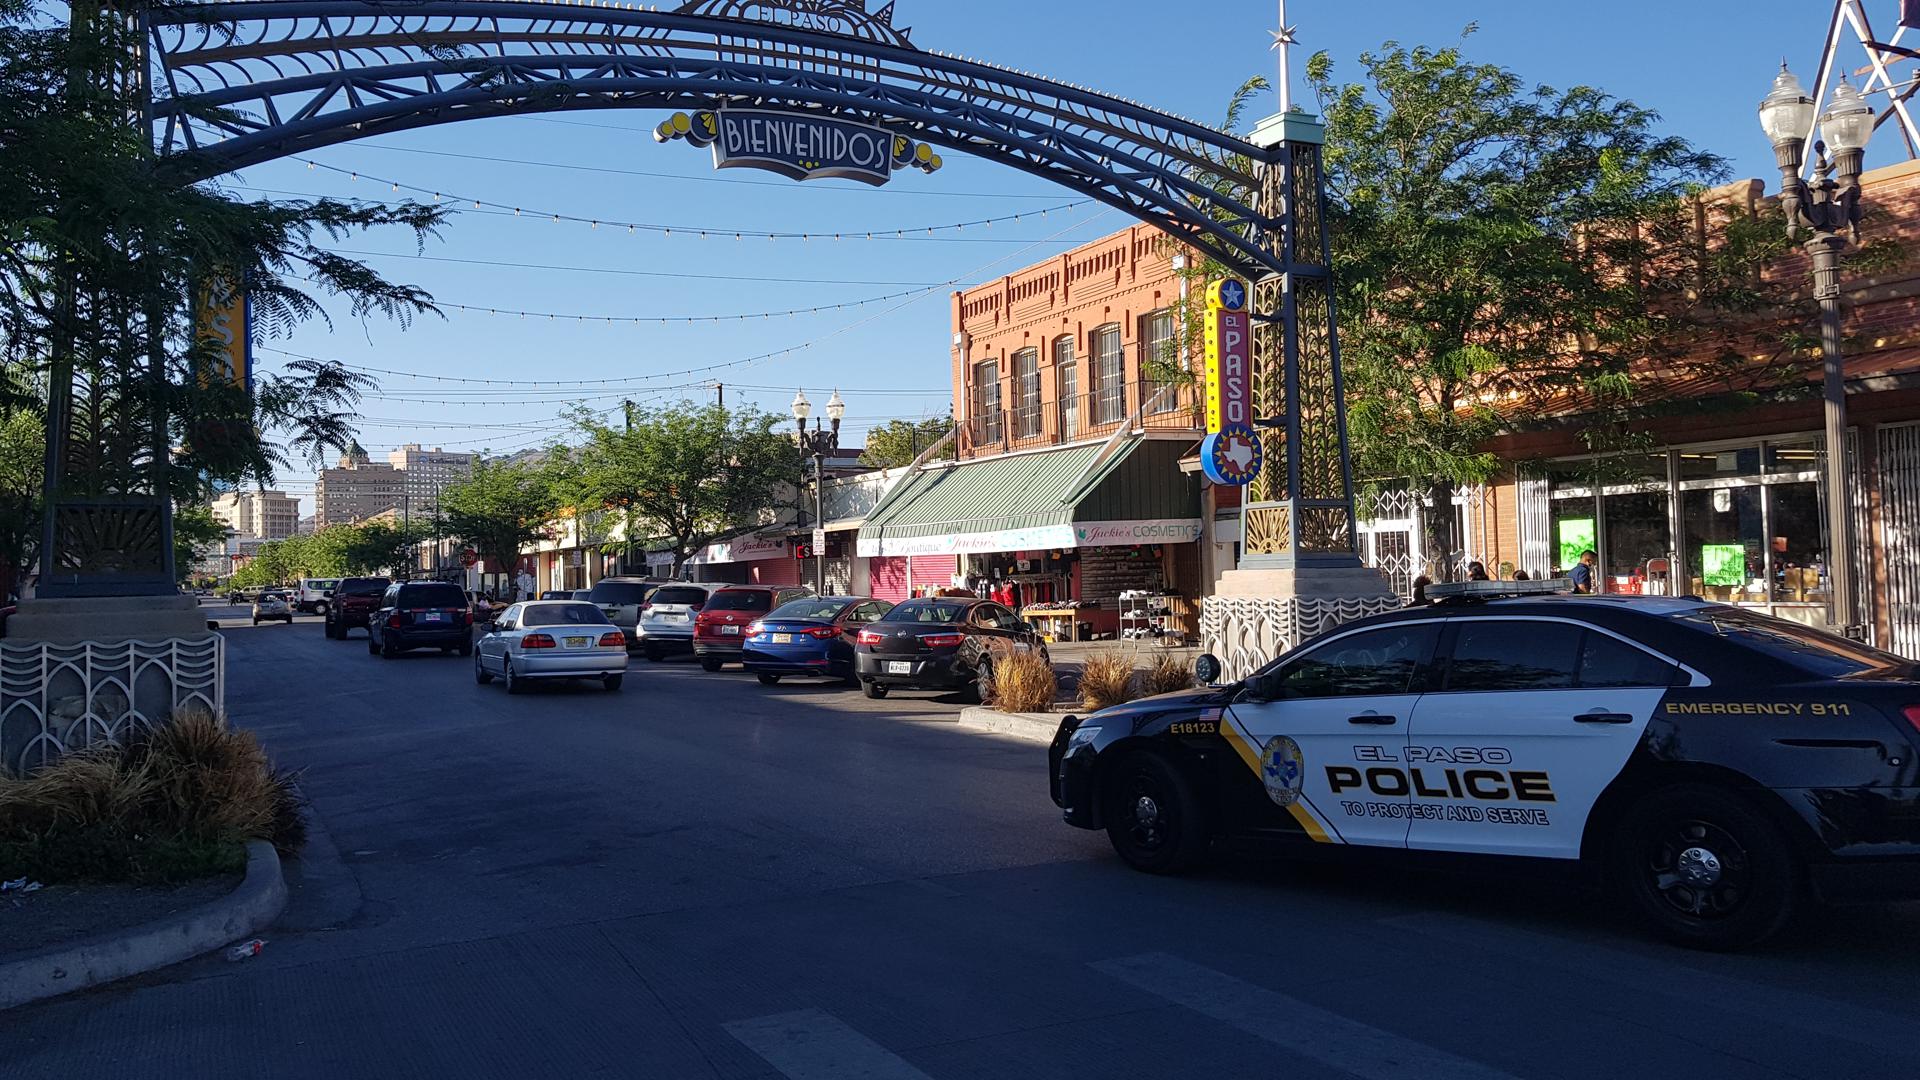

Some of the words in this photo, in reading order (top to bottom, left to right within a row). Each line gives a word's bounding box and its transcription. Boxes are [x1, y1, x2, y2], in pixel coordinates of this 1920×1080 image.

[758, 6, 790, 25] EL
[791, 11, 841, 33] PASO
[725, 118, 885, 169] BIENVENIDOS
[1225, 315, 1240, 328] EL
[1225, 330, 1243, 423] PASO
[1086, 525, 1131, 543] Jackie's
[1132, 524, 1199, 538] COSMETICS
[739, 540, 773, 553] Jackie's
[1665, 702, 1804, 715] EMERGENCY
[1811, 703, 1850, 716] 911
[1170, 722, 1215, 734] E18123
[1353, 745, 1398, 762] EL
[1403, 746, 1512, 764] PASO
[1324, 765, 1558, 802] POLICE
[1341, 800, 1366, 816] TO
[1368, 801, 1444, 820] PROTECT
[1445, 805, 1484, 822] AND
[1485, 807, 1550, 825] SERVE
